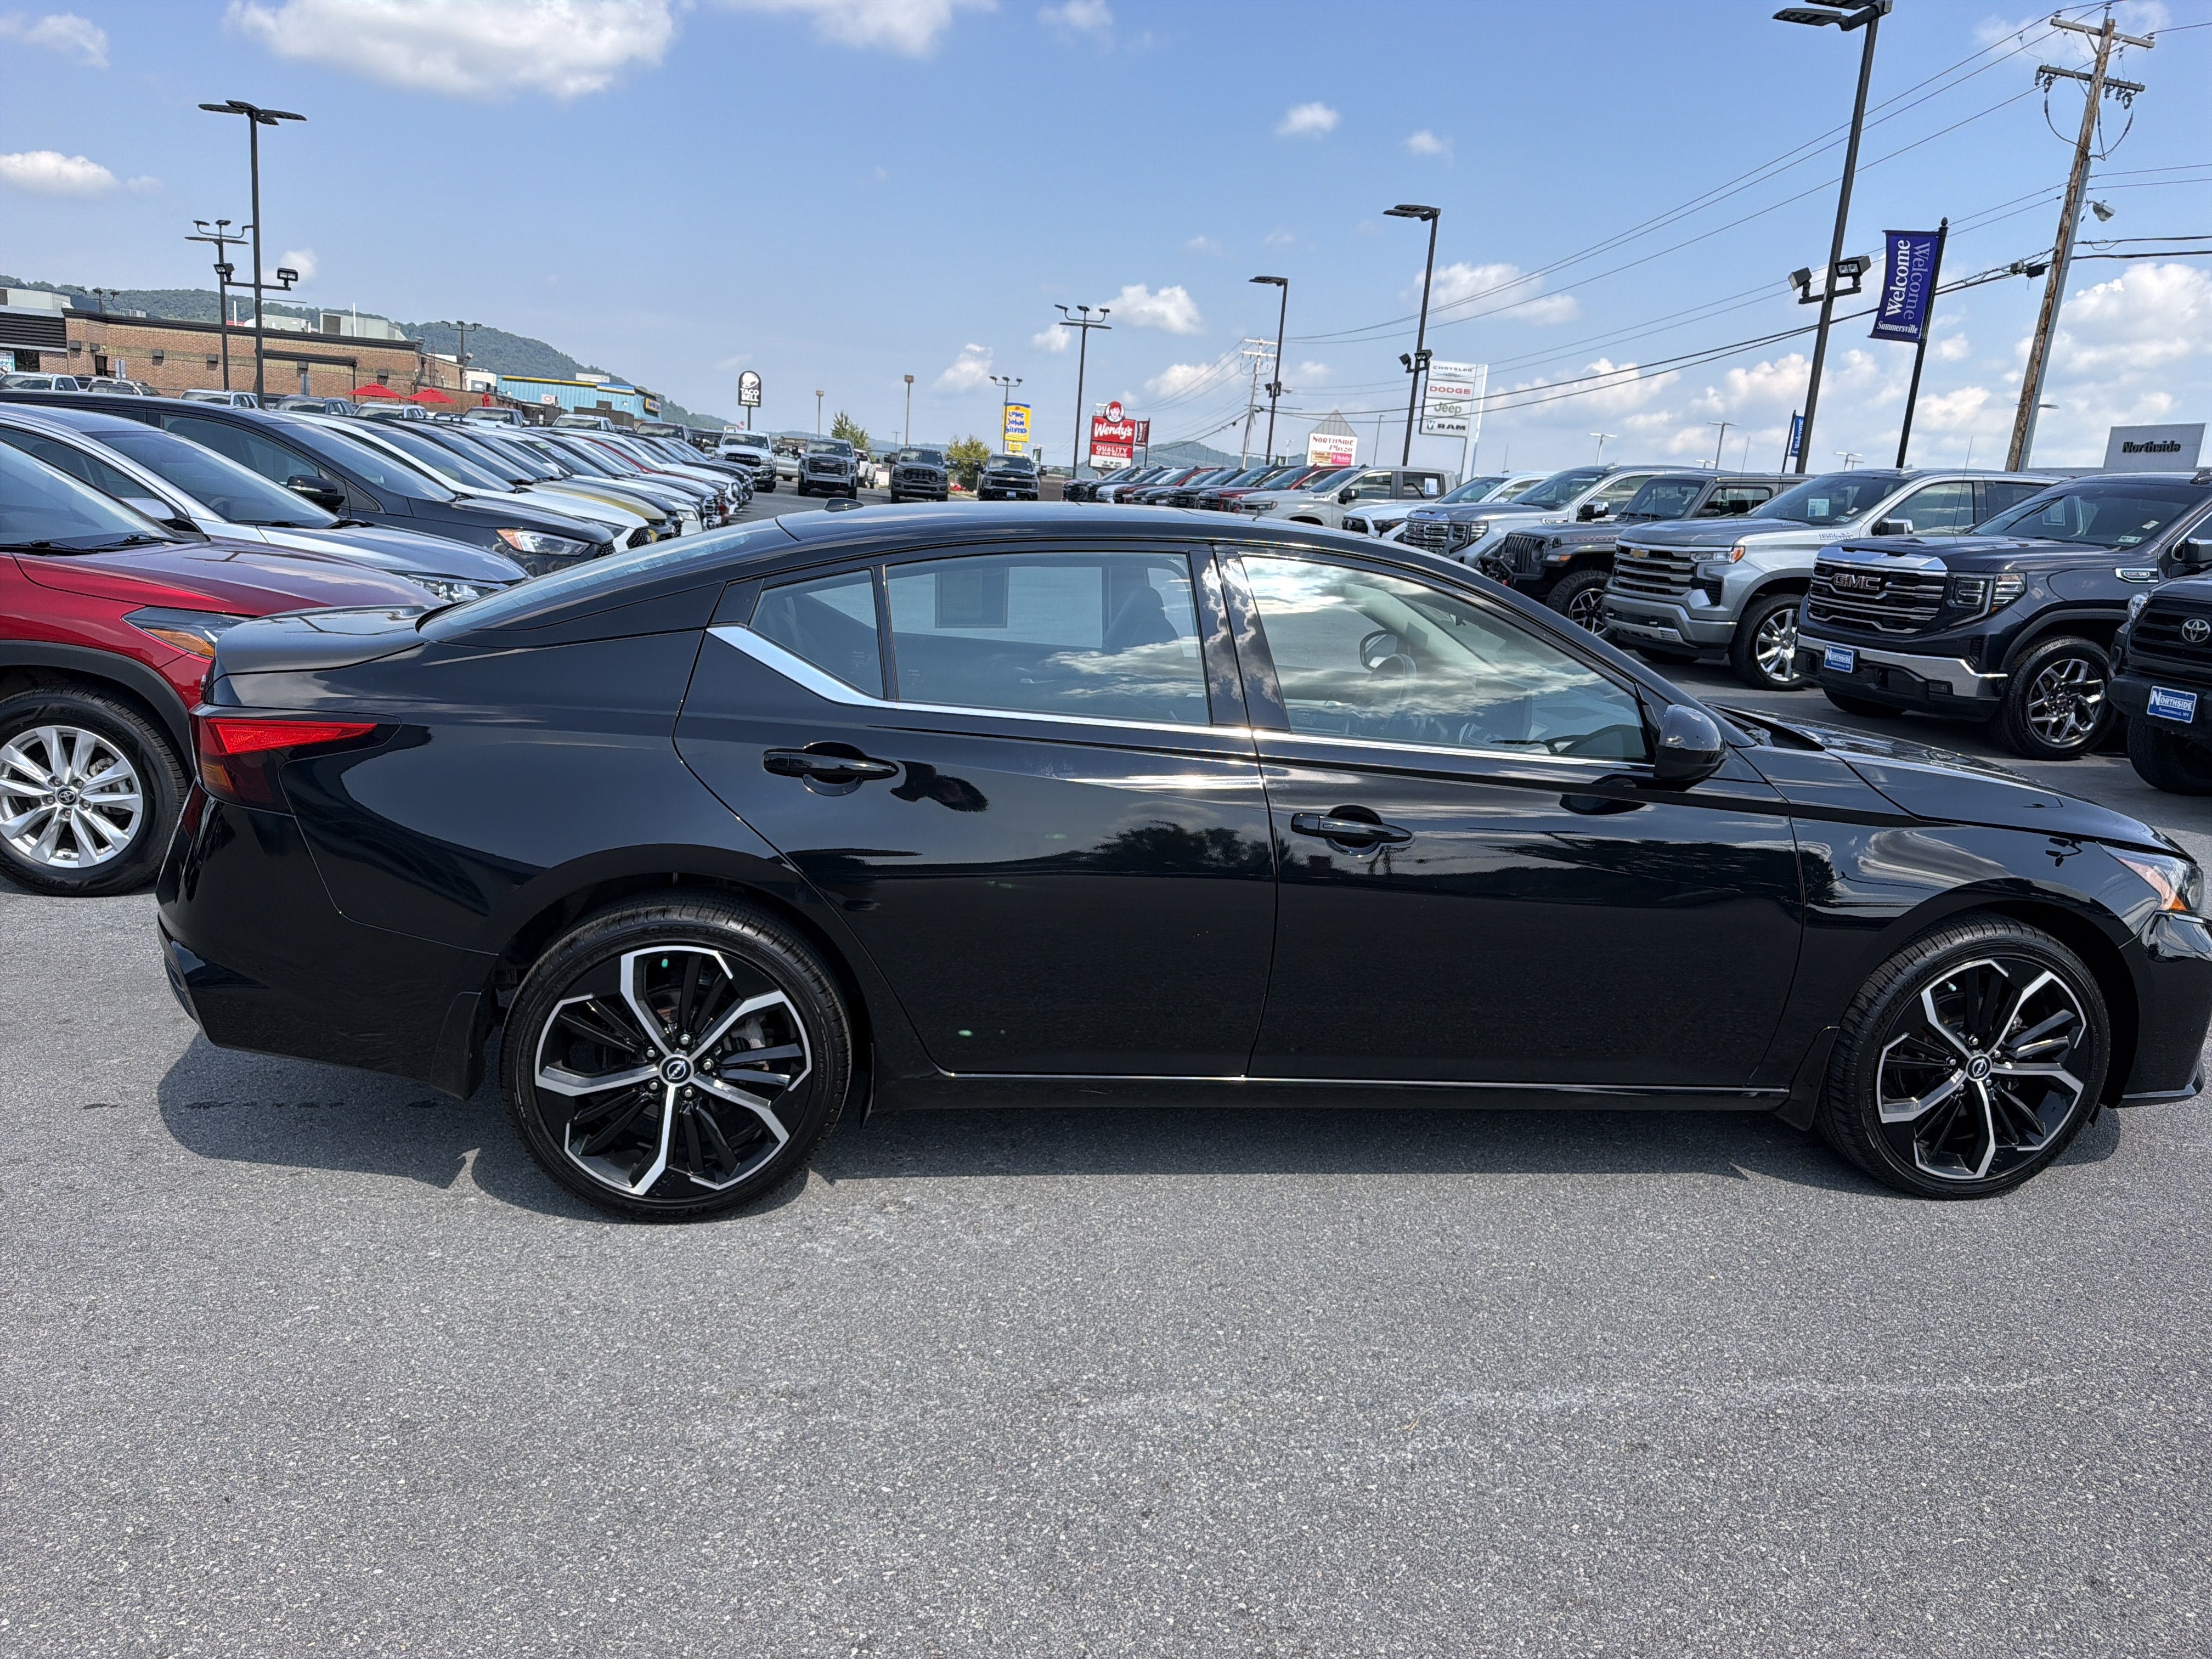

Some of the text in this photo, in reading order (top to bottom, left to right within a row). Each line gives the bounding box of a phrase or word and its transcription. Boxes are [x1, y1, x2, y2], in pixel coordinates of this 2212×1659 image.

[1884, 239, 1910, 317] Welcome
[1903, 241, 1931, 320] Welcome
[1876, 320, 1918, 334] Summersville
[740, 387, 759, 396] TACO
[1429, 386, 1471, 394] DODGE
[1434, 402, 1462, 415] Jeep
[1094, 421, 1133, 440] Wendy's
[1312, 436, 1354, 445] NORTHSIDE
[2121, 440, 2181, 453] Northside
[1096, 445, 1128, 453] QUALITY
[1833, 572, 1881, 591] GMC
[1825, 648, 1852, 664] NORTHSIDE
[2150, 690, 2193, 709] NORTHSIDE
